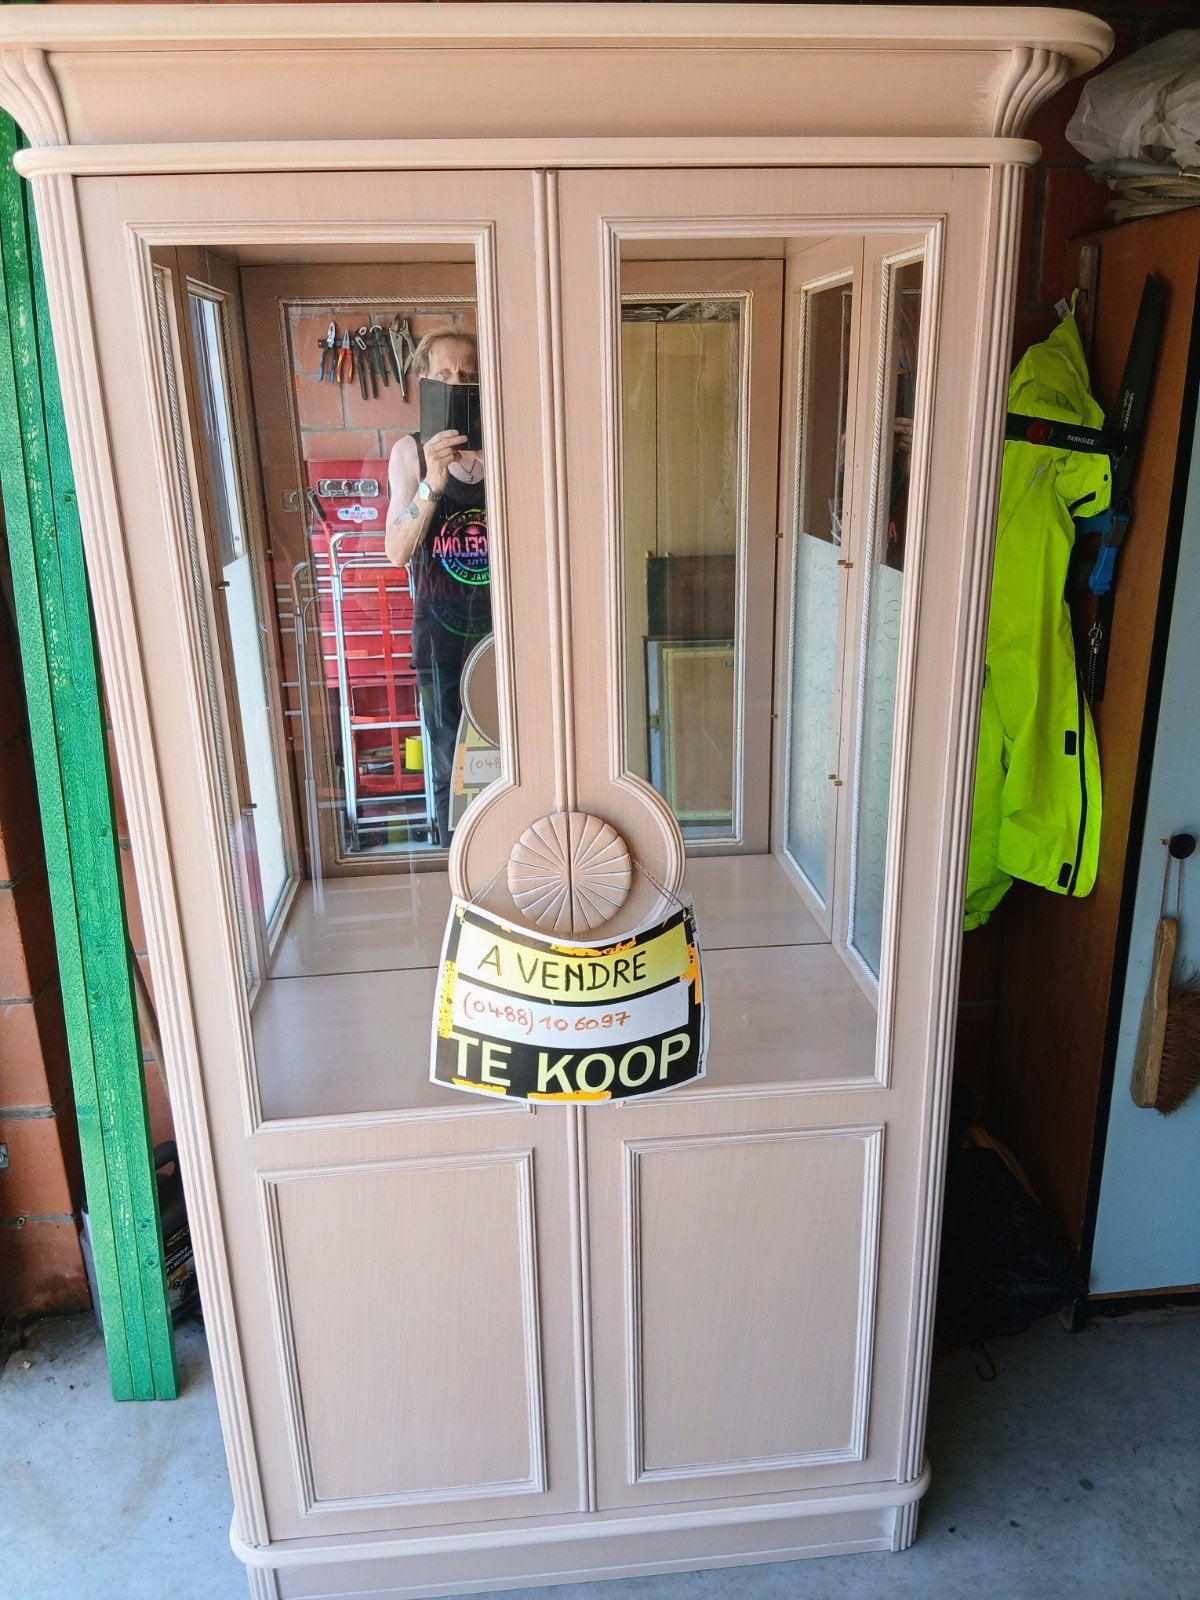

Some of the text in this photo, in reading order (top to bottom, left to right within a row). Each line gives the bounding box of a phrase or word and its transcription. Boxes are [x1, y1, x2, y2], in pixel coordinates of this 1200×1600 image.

[1067, 434, 1095, 446] PARKSIDE
[477, 944, 647, 992] A VENDRE
[463, 991, 533, 1035] (0488)
[451, 1032, 691, 1093] TE KOOP
